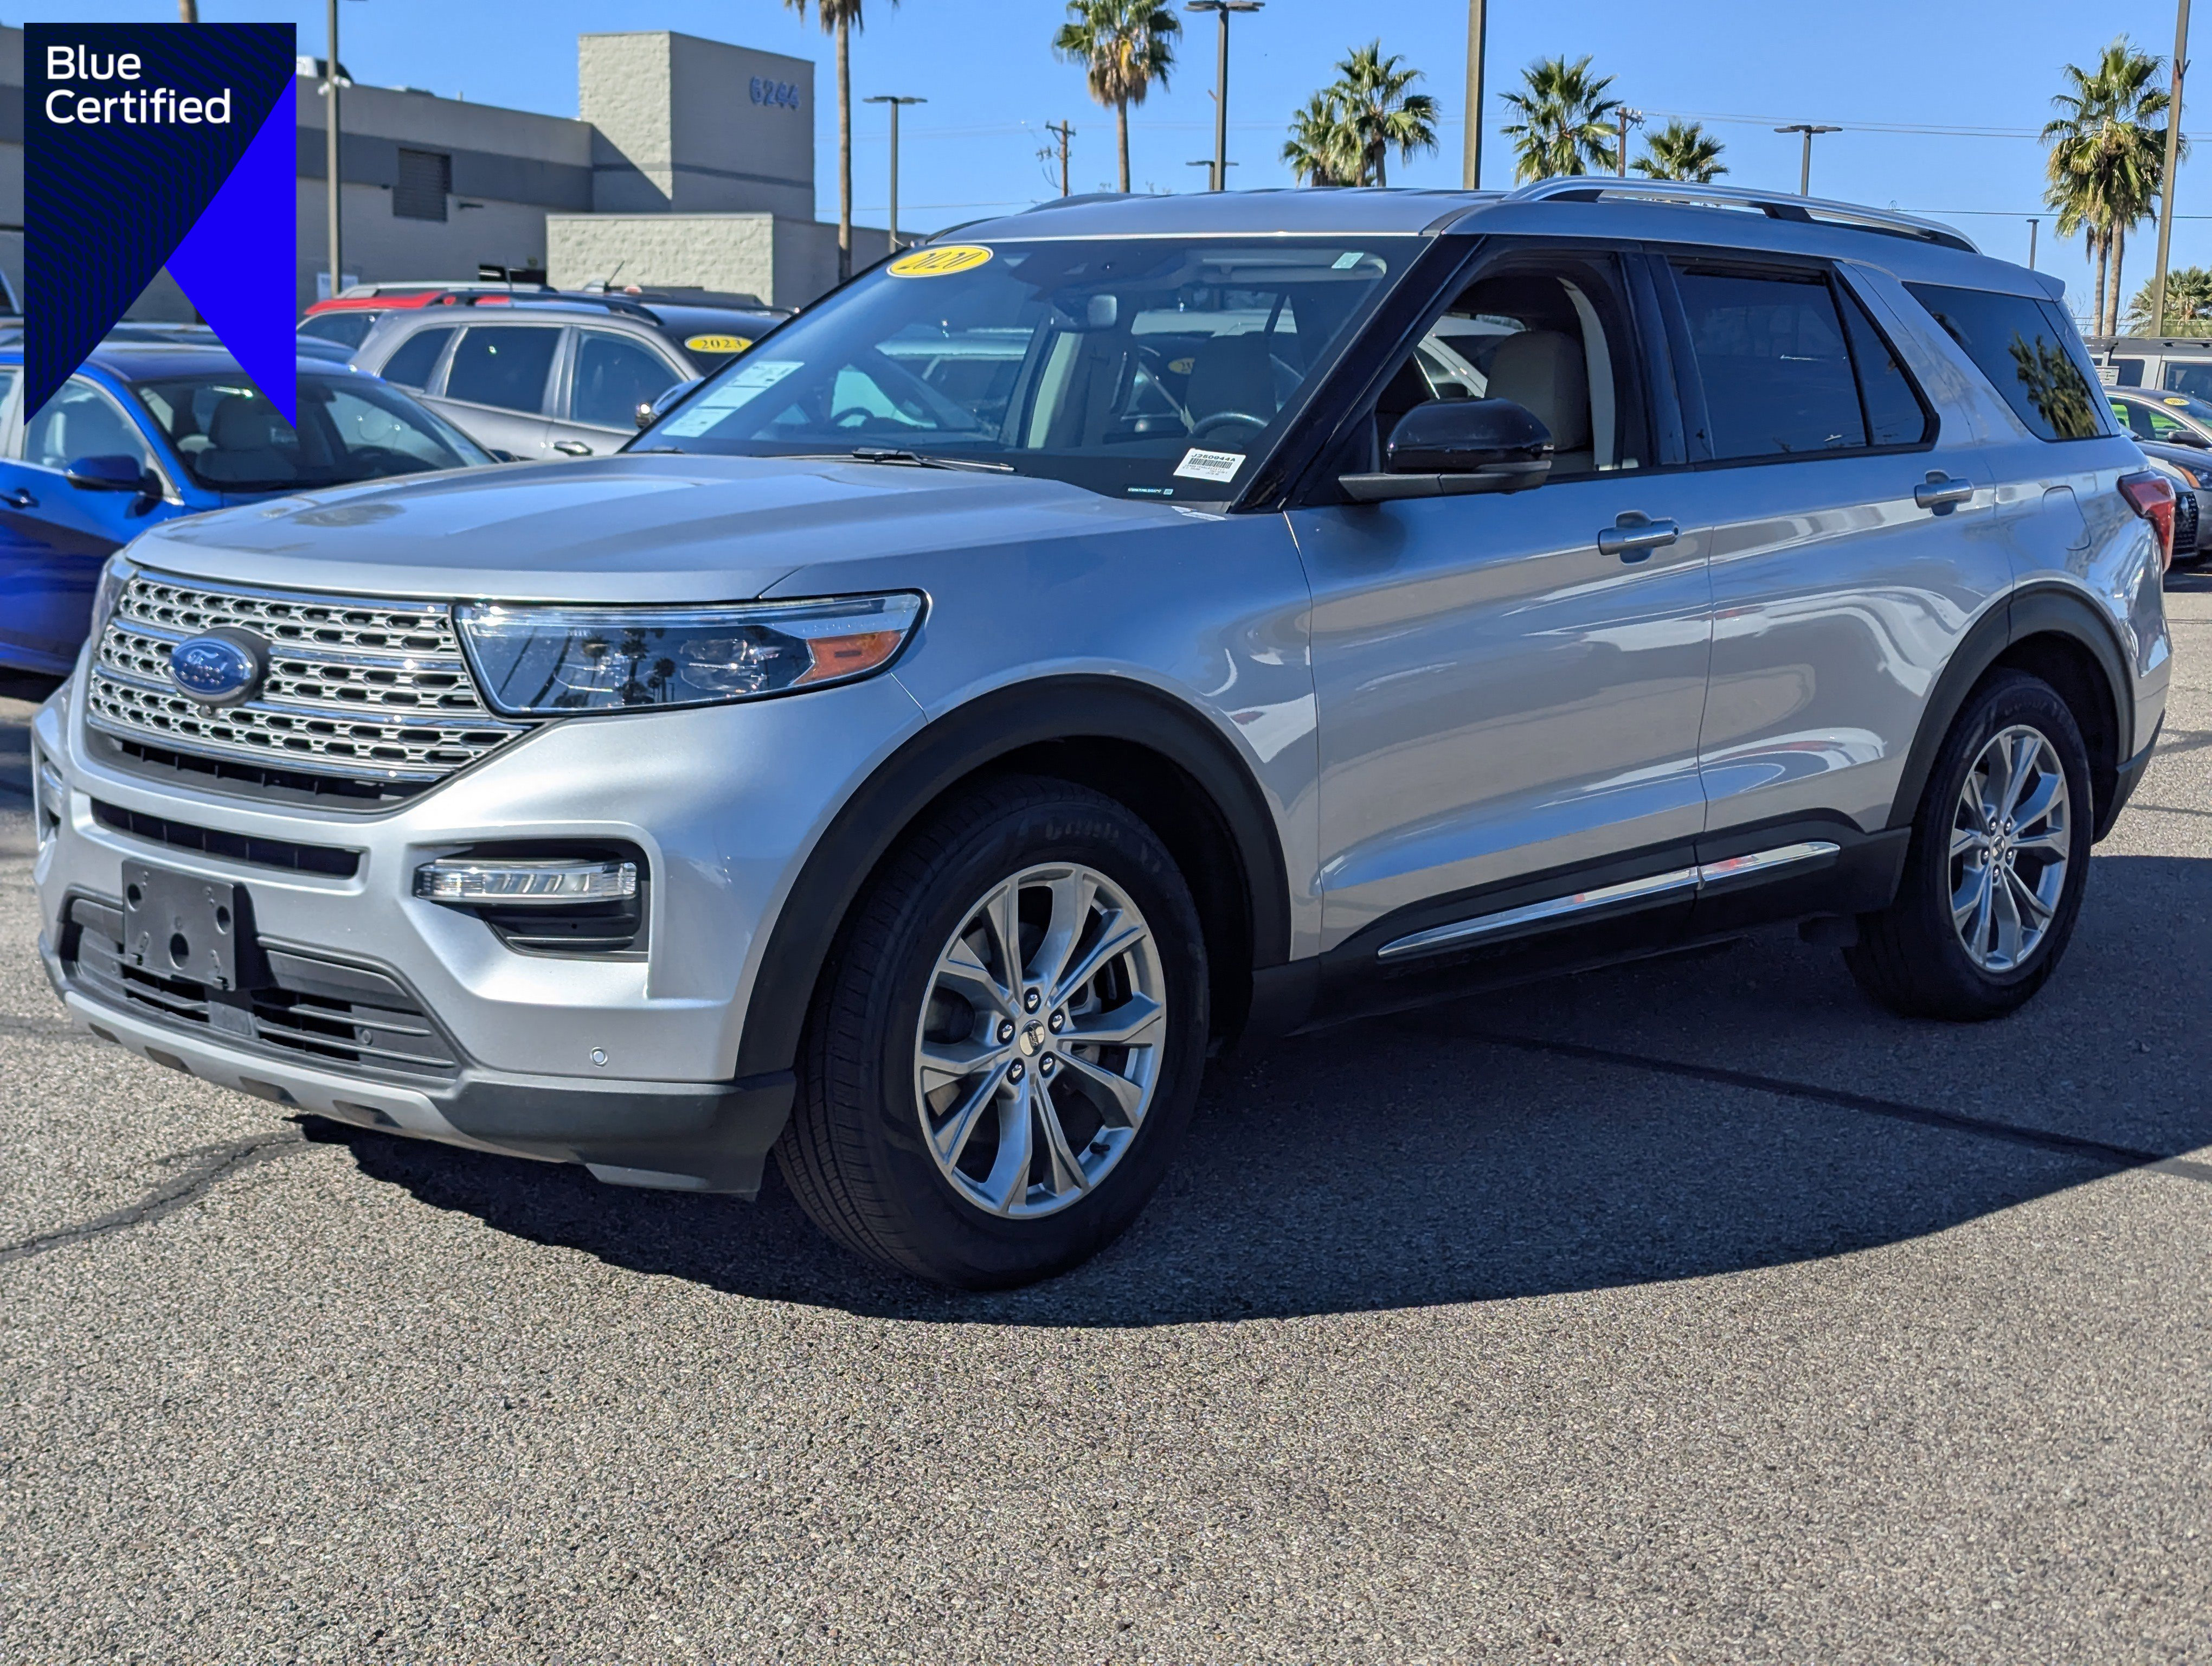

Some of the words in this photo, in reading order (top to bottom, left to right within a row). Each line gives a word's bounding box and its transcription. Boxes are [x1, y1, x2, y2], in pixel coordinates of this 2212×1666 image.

[750, 76, 800, 110] 6244
[897, 252, 983, 270] 2020
[701, 338, 742, 349] 2023
